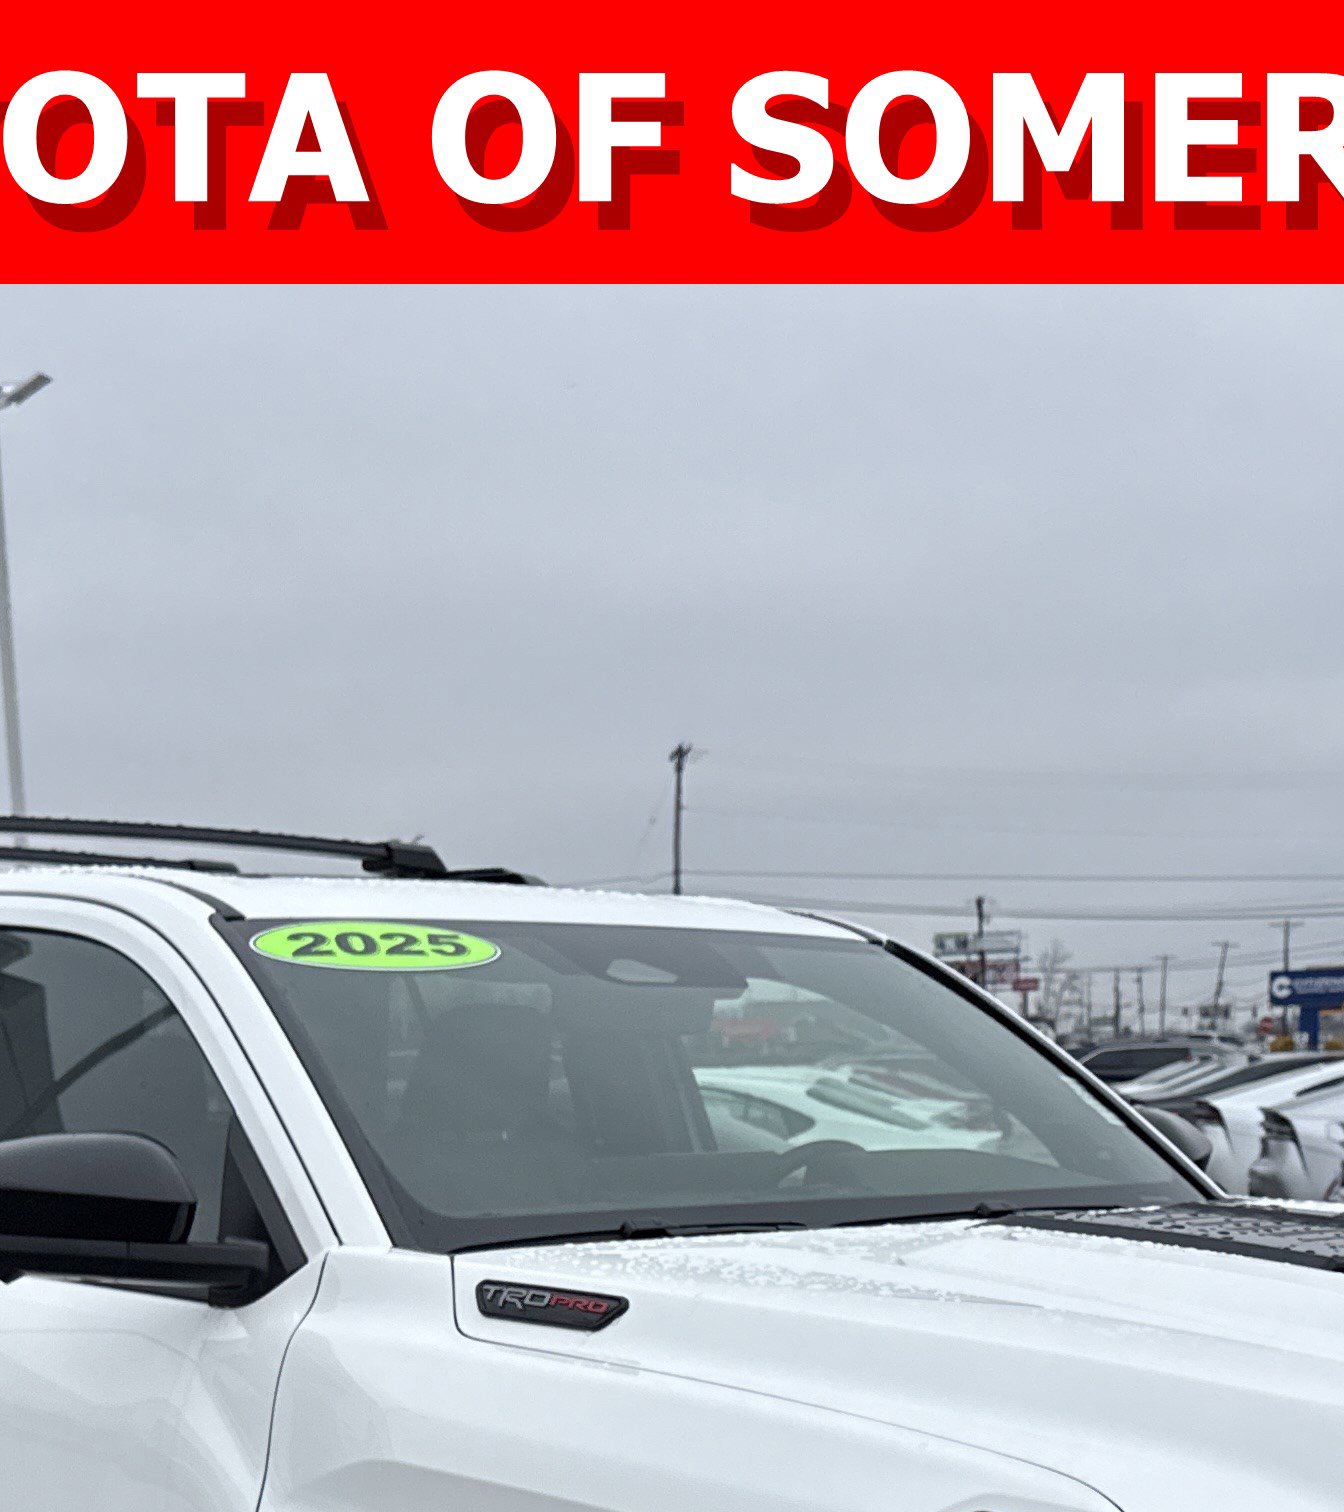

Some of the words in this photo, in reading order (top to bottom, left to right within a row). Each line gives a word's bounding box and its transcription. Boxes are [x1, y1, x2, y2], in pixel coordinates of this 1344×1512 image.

[286, 931, 472, 958] 2025
[482, 1284, 551, 1310] TRD
[548, 1294, 610, 1314] PRO
